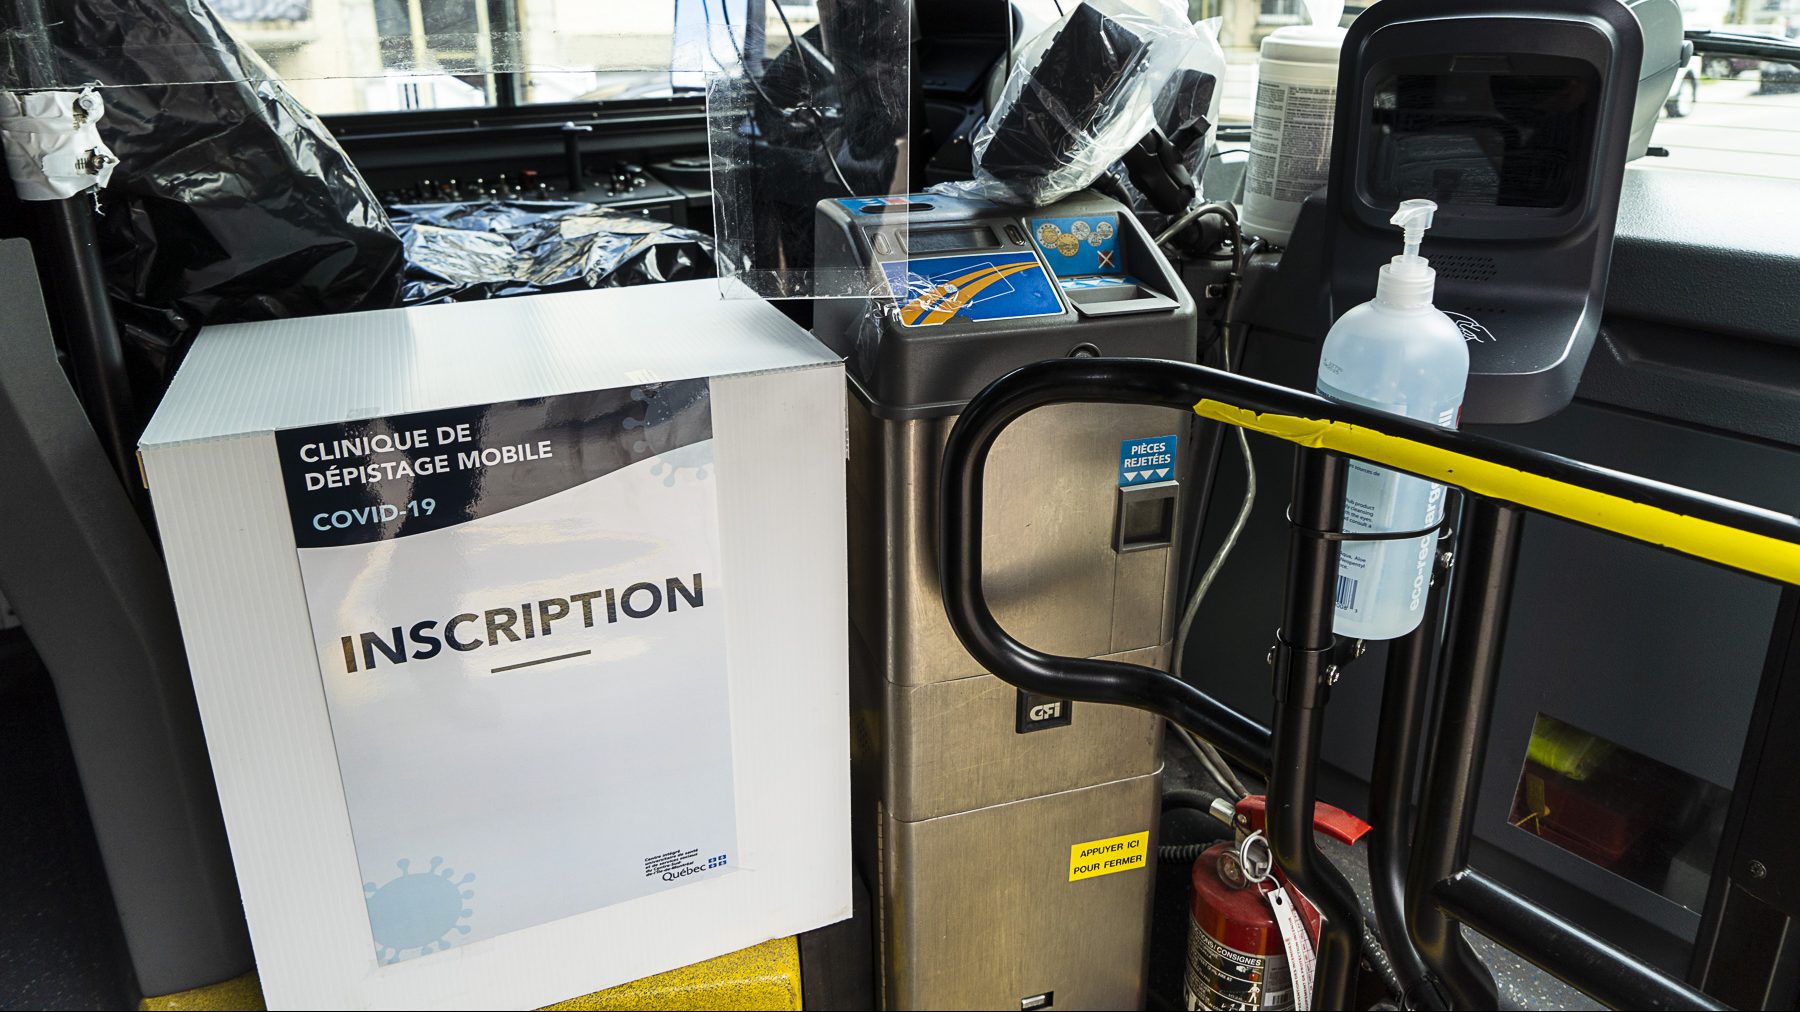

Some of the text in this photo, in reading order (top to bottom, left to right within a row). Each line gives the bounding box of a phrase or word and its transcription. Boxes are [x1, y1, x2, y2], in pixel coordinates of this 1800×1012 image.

[300, 423, 472, 462] CLINIQUE DE
[1131, 442, 1166, 455] PIÈCES
[305, 440, 553, 491] DÉPISTAGE MOBILE
[1124, 453, 1171, 468] REJETÉES
[312, 498, 436, 531] COVID-19
[1354, 501, 1375, 511] product
[340, 573, 704, 673] INSCRIPTION
[1030, 702, 1060, 721] GFI
[1080, 839, 1140, 858] APPUYER ICI
[662, 864, 707, 881] Québec
[1073, 854, 1142, 875] POUR FERMER
[1216, 946, 1261, 966] CONSIGNES
